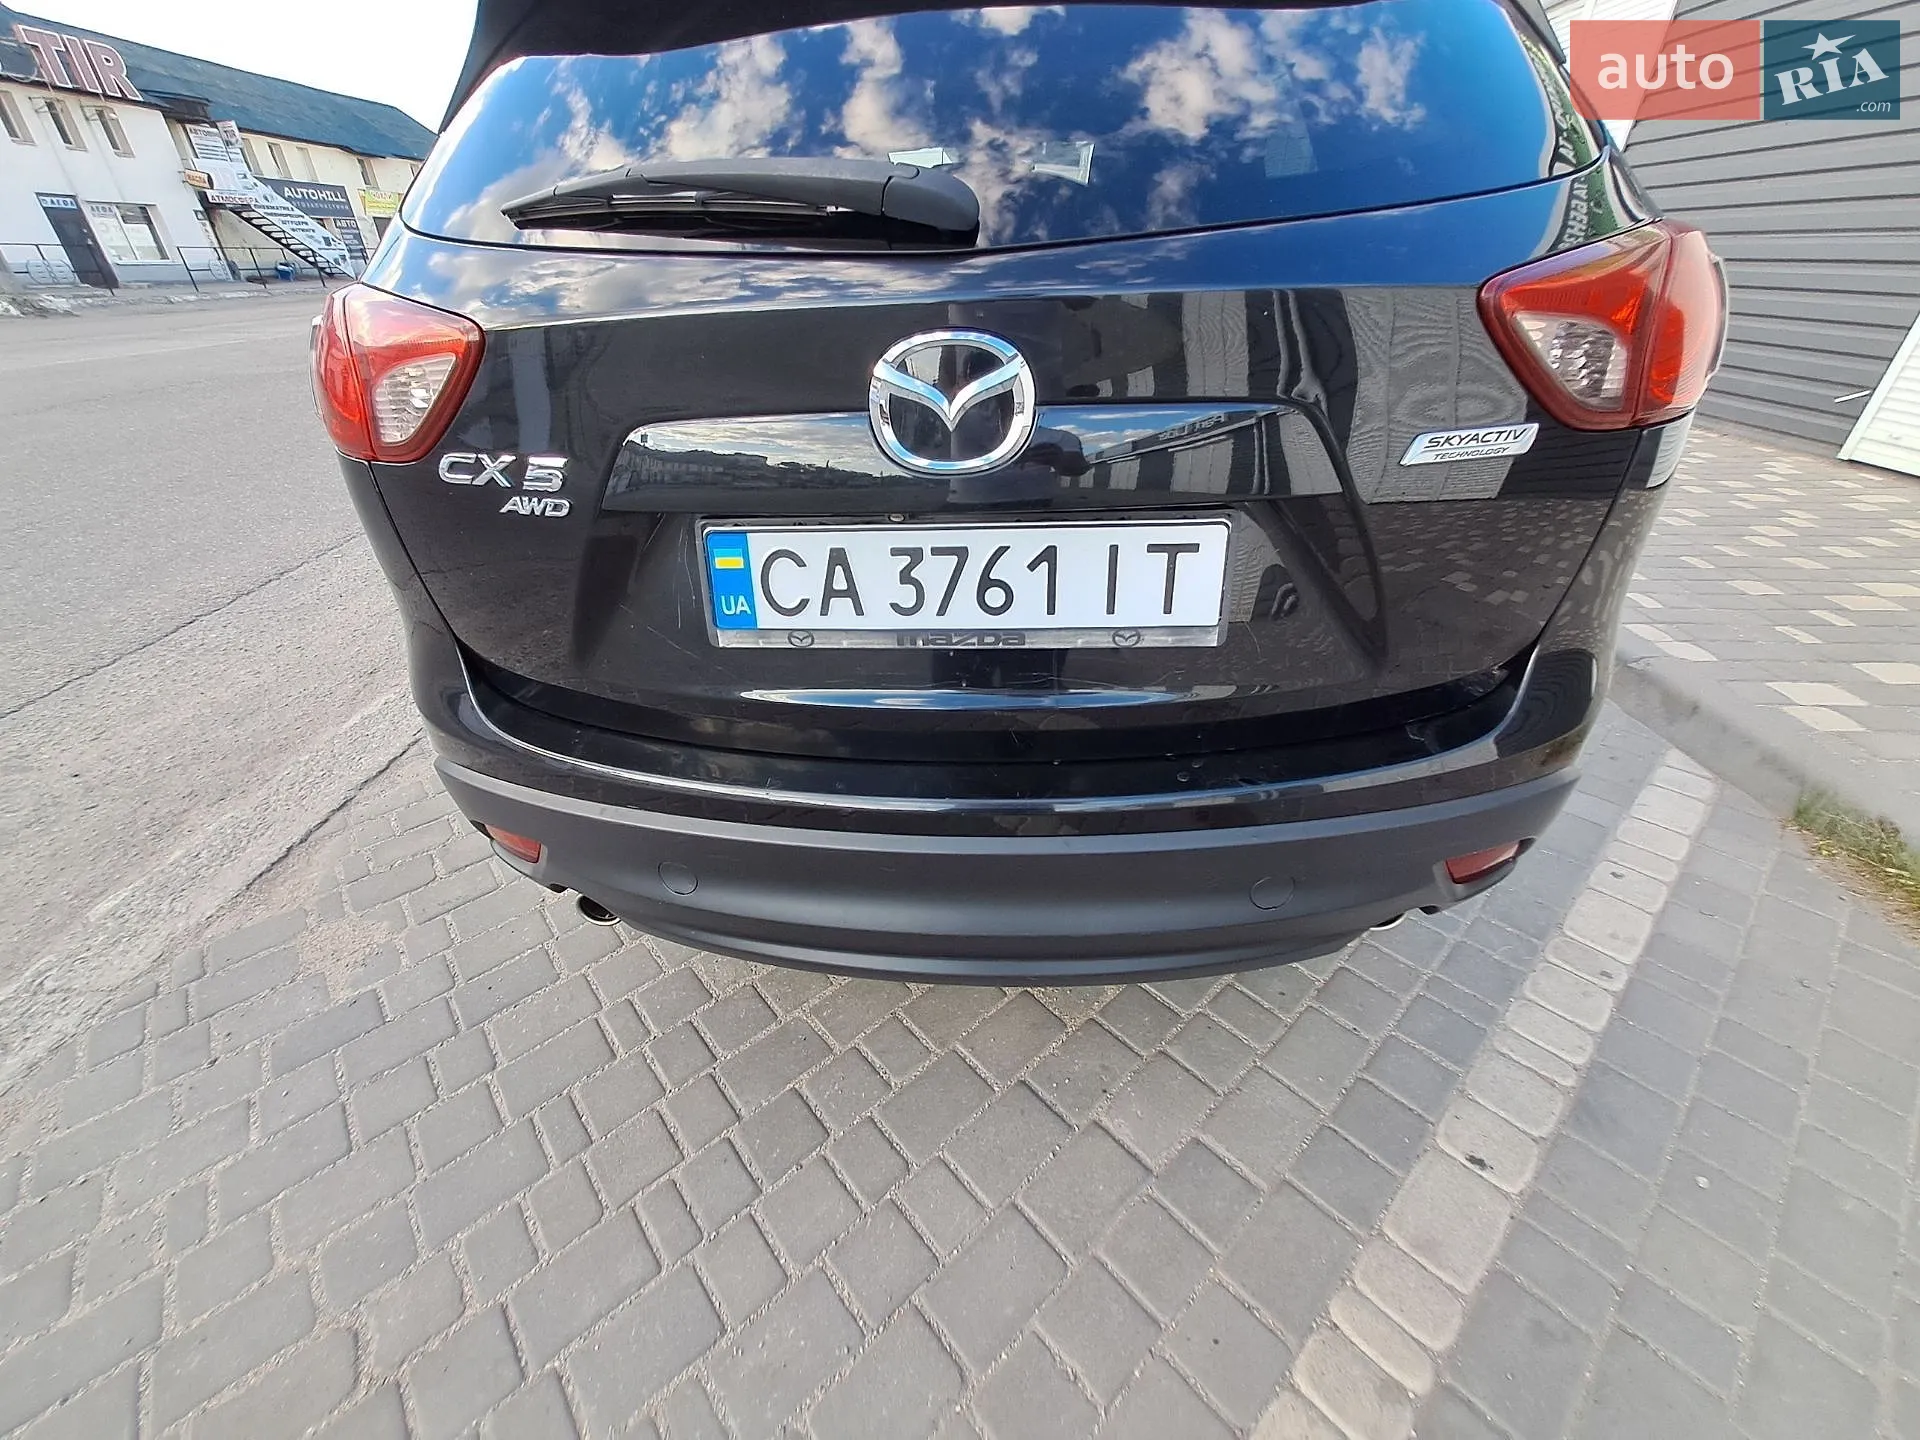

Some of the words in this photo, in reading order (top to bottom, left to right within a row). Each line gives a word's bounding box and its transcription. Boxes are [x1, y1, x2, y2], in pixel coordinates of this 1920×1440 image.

[12, 24, 144, 101] TIR
[284, 186, 348, 201] AUTOHILL
[1424, 428, 1528, 449] SKYACTIV
[1433, 446, 1510, 461] TECHNOLOGY
[499, 495, 572, 518] AWD
[760, 547, 865, 617] CA
[888, 544, 1058, 617] 3761
[1106, 543, 1201, 616] IT
[720, 595, 752, 616] UA
